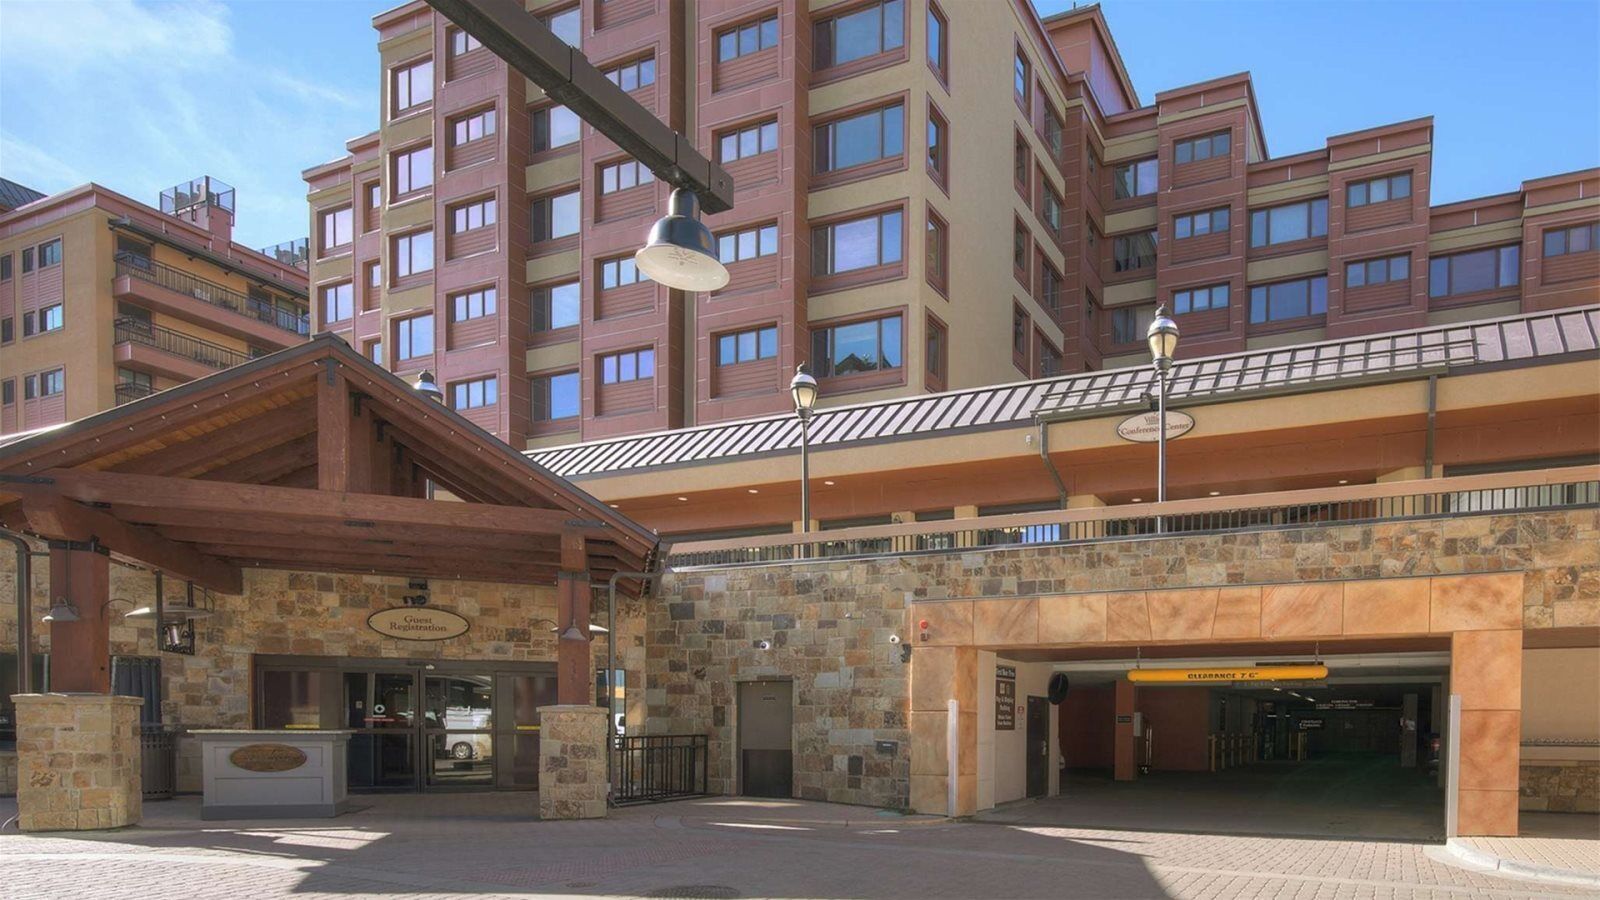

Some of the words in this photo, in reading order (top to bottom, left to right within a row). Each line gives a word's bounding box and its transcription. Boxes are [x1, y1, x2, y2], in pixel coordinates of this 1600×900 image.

[1164, 423, 1190, 431] Center
[404, 615, 432, 624] Guest
[389, 622, 447, 632] Registration
